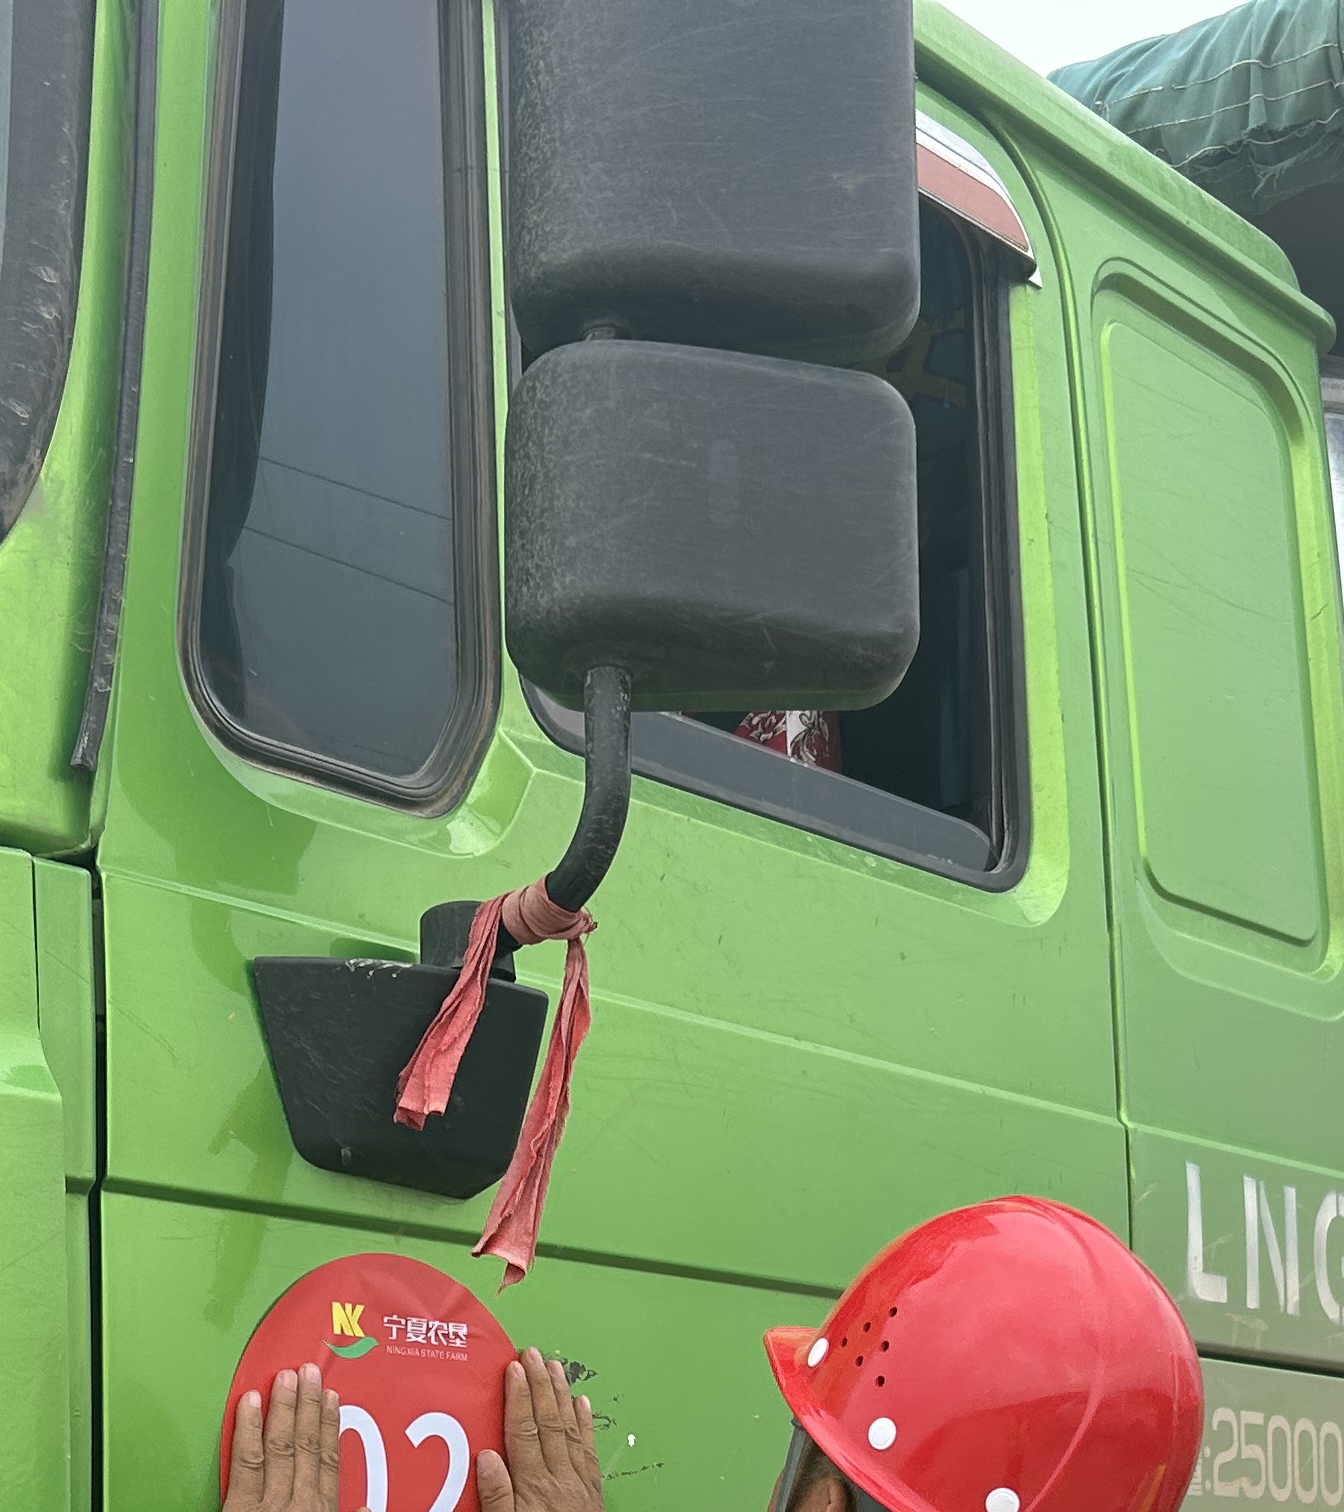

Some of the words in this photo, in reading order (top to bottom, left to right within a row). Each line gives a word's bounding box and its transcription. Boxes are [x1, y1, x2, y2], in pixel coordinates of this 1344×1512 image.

[383, 1314, 468, 1348] 宁夏农垦
[420, 1348, 444, 1360] STATE
[446, 1351, 468, 1361] FARM
